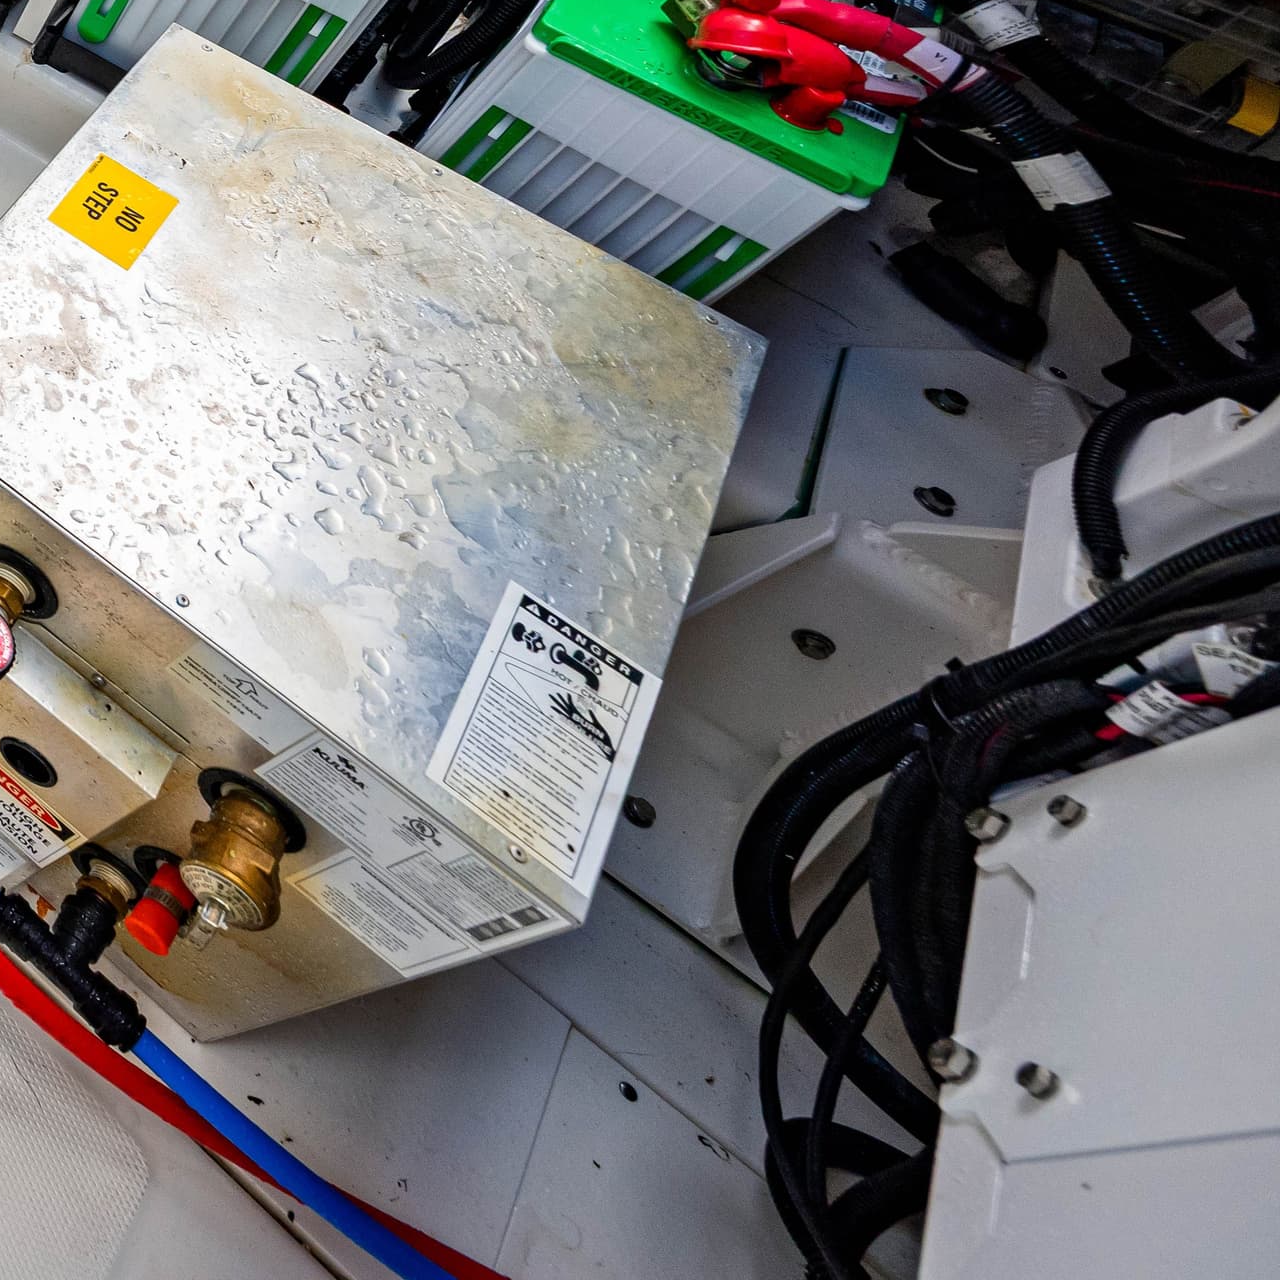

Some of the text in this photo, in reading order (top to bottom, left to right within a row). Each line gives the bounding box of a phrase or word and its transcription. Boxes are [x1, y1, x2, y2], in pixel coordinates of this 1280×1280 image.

[82, 182, 119, 220] STEP
[115, 206, 145, 233] NO
[538, 614, 640, 677] DANGER
[547, 666, 624, 719] HOT CHAUD
[308, 744, 370, 791] KUUMA
[6, 801, 46, 833] HIGH
